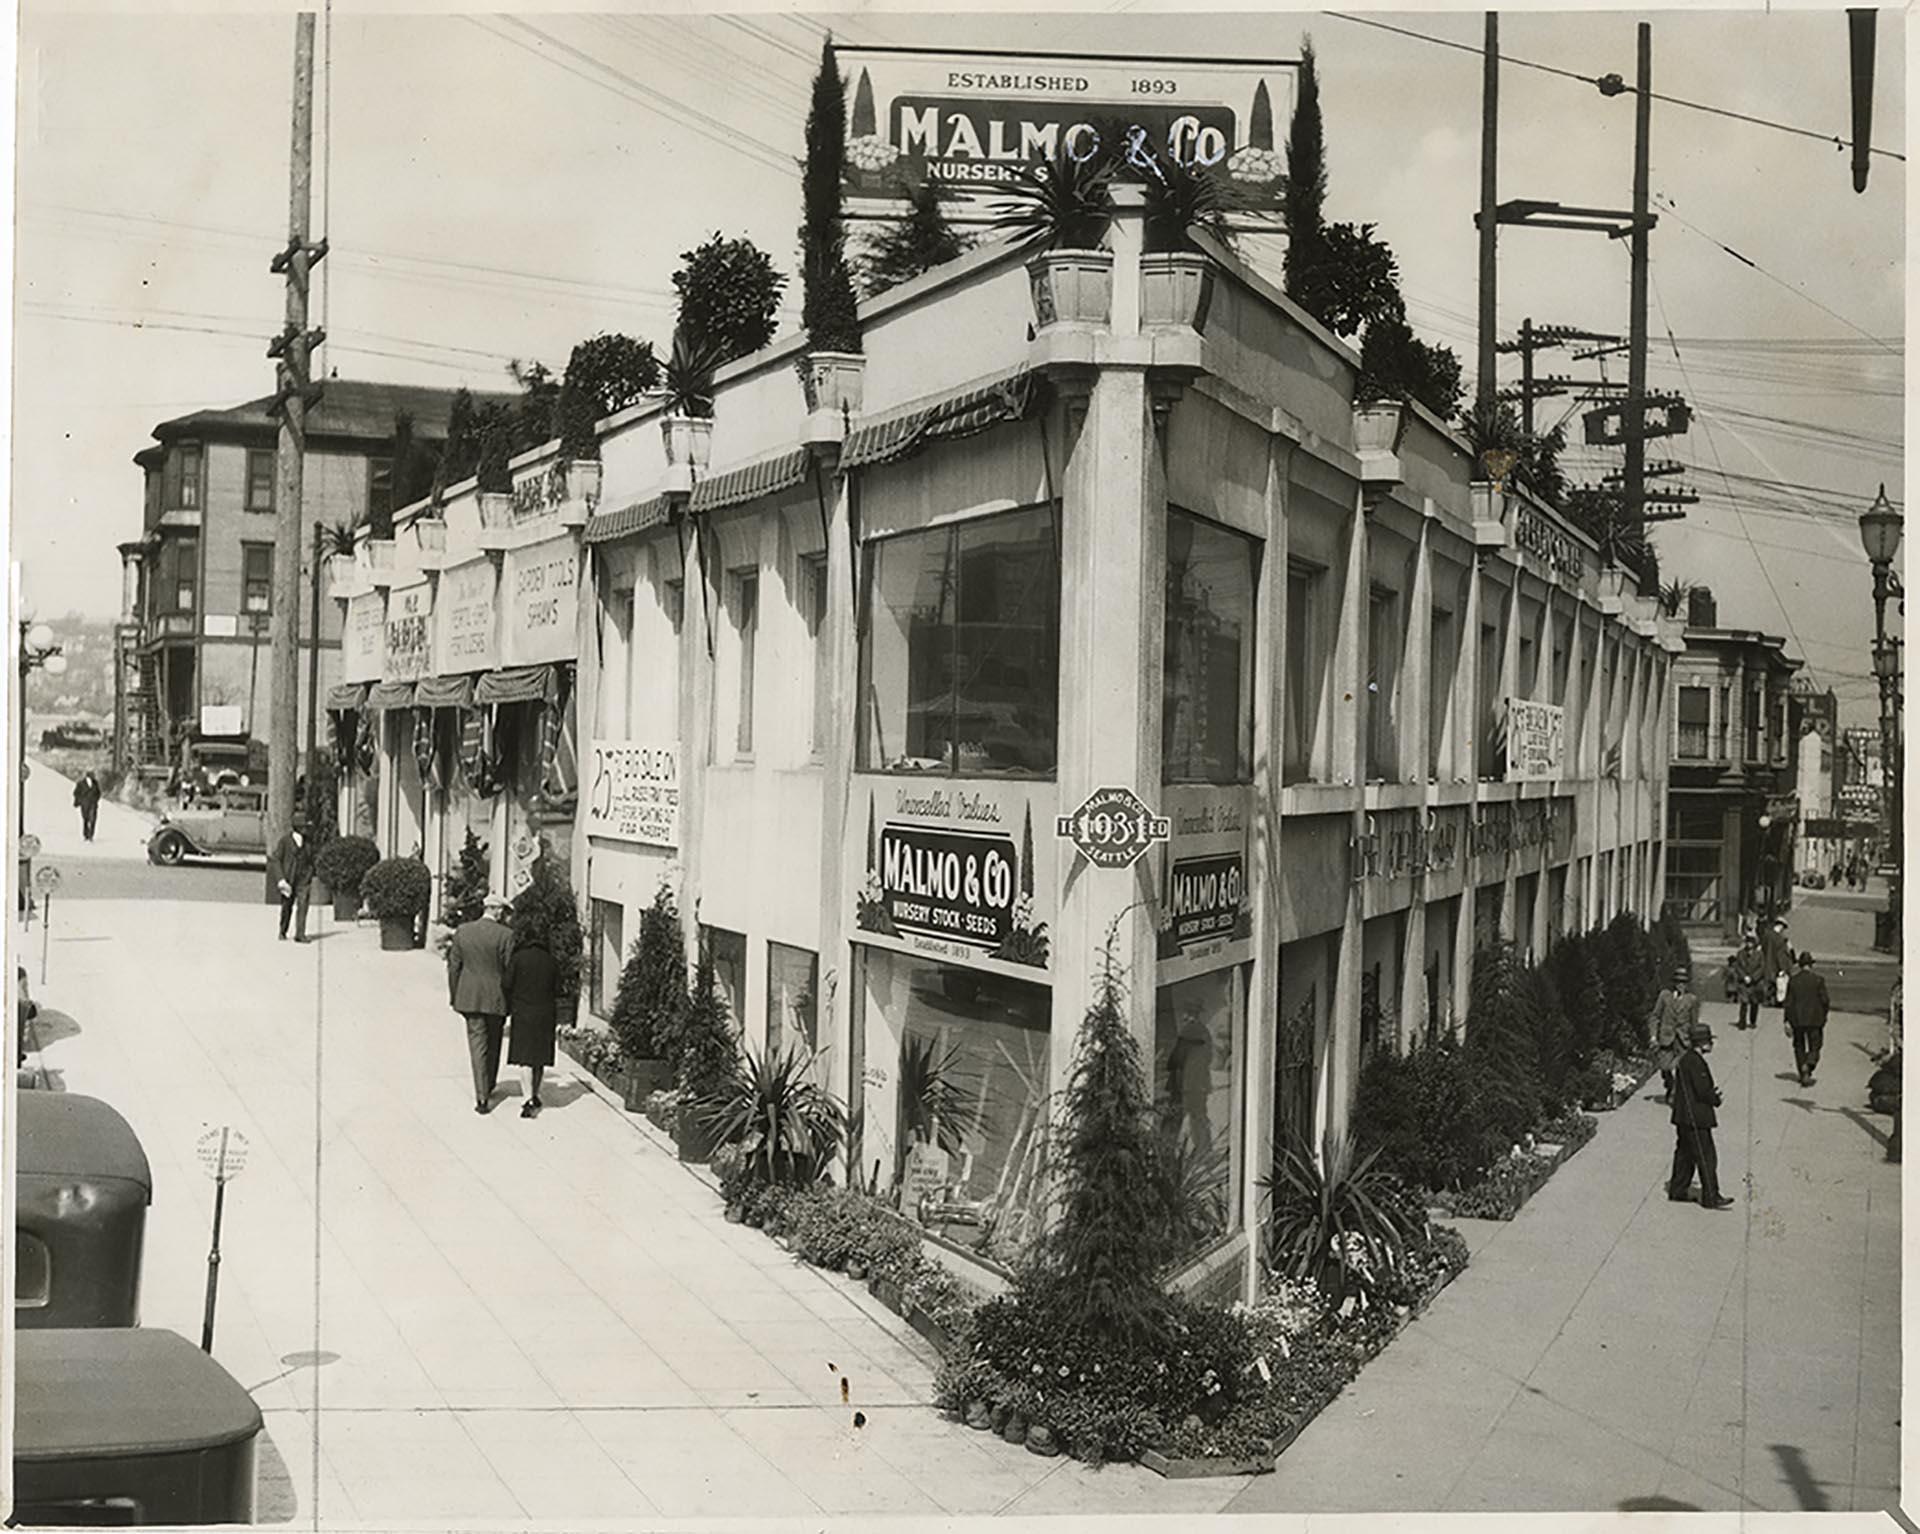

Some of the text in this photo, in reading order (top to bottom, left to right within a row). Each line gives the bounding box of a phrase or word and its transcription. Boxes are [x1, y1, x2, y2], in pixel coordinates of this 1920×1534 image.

[948, 73, 1177, 94] ESTABLISHED 1893
[900, 105, 1100, 163] MALMO
[927, 162, 1026, 182] NURSERY
[1077, 811, 1149, 845] 1931
[1087, 845, 1137, 862] SEATTLE
[883, 837, 960, 901] MALMO
[964, 854, 980, 908] &
[1172, 872, 1217, 917] MALMO
[1218, 871, 1228, 910] &
[893, 900, 998, 936] NURSERY STOCK SEEDS
